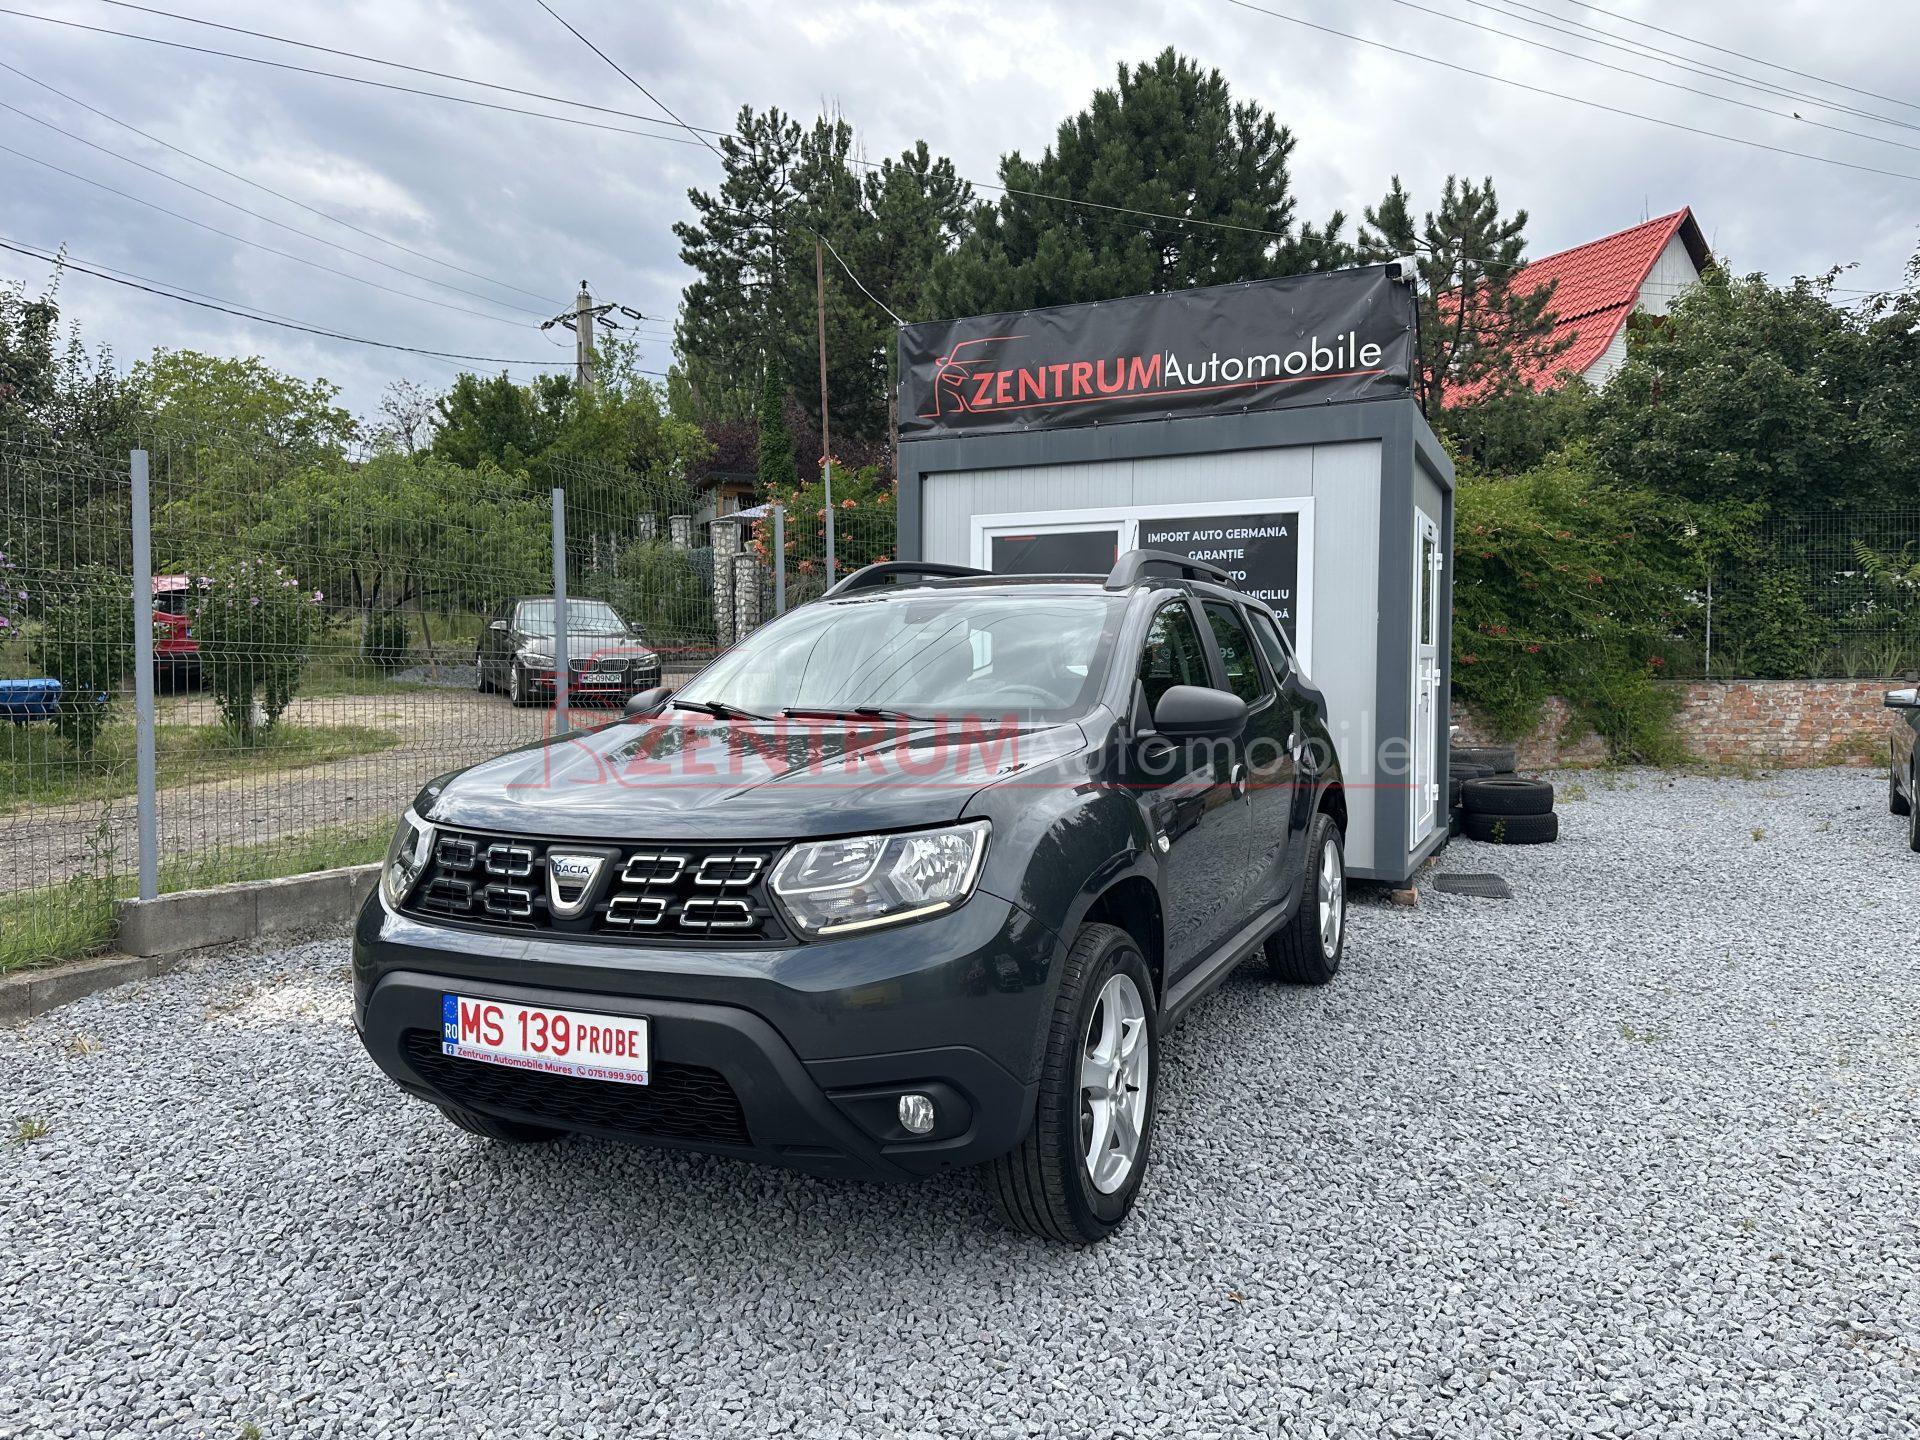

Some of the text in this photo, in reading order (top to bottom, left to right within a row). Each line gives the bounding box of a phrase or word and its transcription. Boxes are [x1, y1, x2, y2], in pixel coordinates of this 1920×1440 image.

[970, 330, 1382, 406] ZENTRUM Automobile
[1147, 526, 1288, 543] IMPORT AUTO GERMANIA
[1229, 570, 1247, 581] TO
[1241, 589, 1290, 600] MICILIU
[554, 863, 590, 875] DACIA
[445, 1002, 639, 1058] RO MS 139 PROBE
[457, 1047, 492, 1062] Zentrum
[494, 1054, 543, 1070] Automobile
[545, 1062, 573, 1075] Mures
[587, 1068, 644, 1083] 0751.999.900
